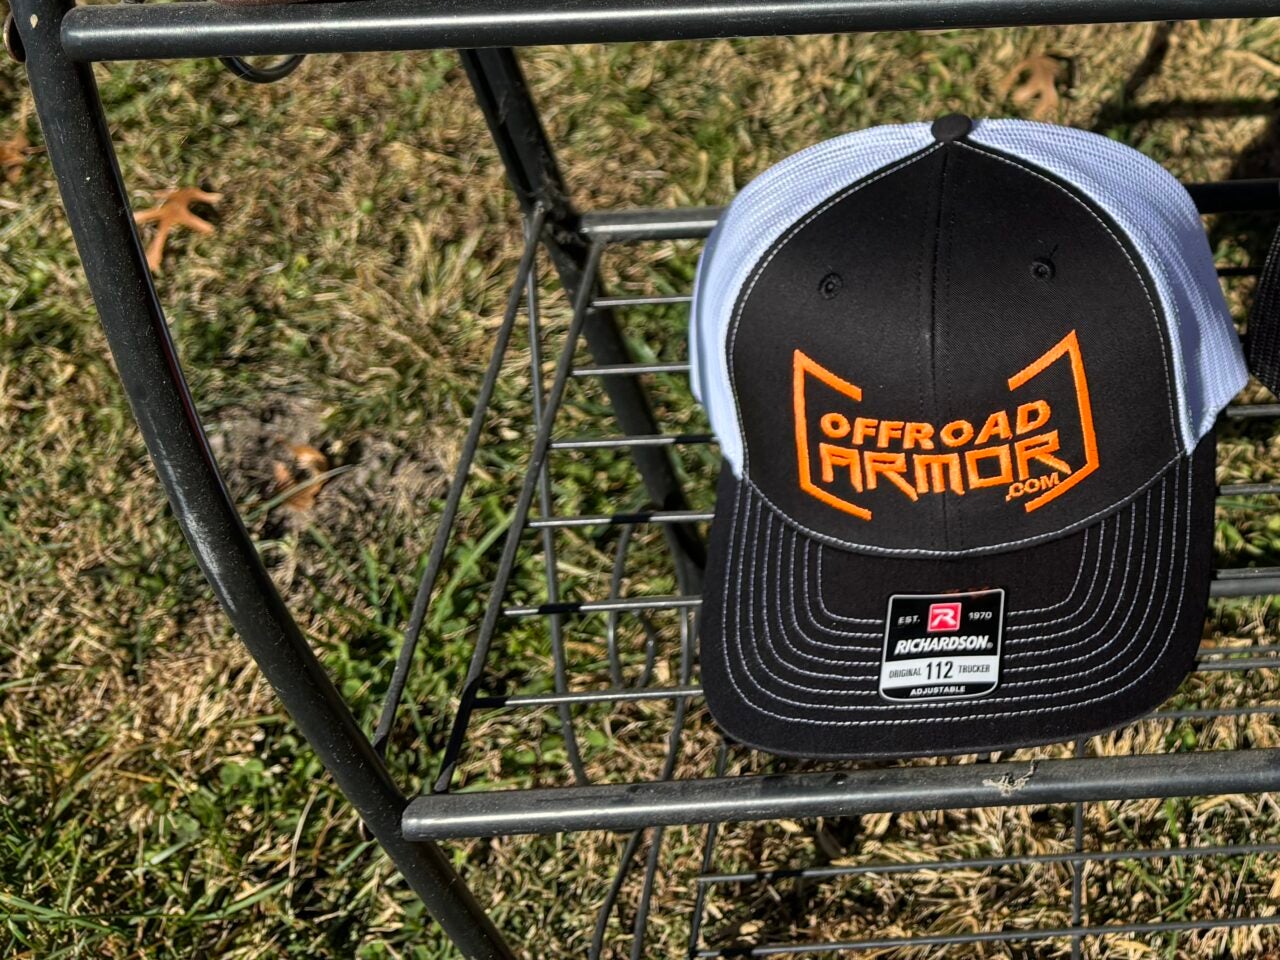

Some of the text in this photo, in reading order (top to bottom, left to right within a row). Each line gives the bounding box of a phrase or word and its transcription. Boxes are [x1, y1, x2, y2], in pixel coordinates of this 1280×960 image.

[820, 399, 1051, 449] OFFROAD
[819, 430, 1072, 502] ARMOR
[889, 661, 990, 680] ORIGINAL 112 TRUCKER
[910, 686, 965, 696] ADJUSTABLE
